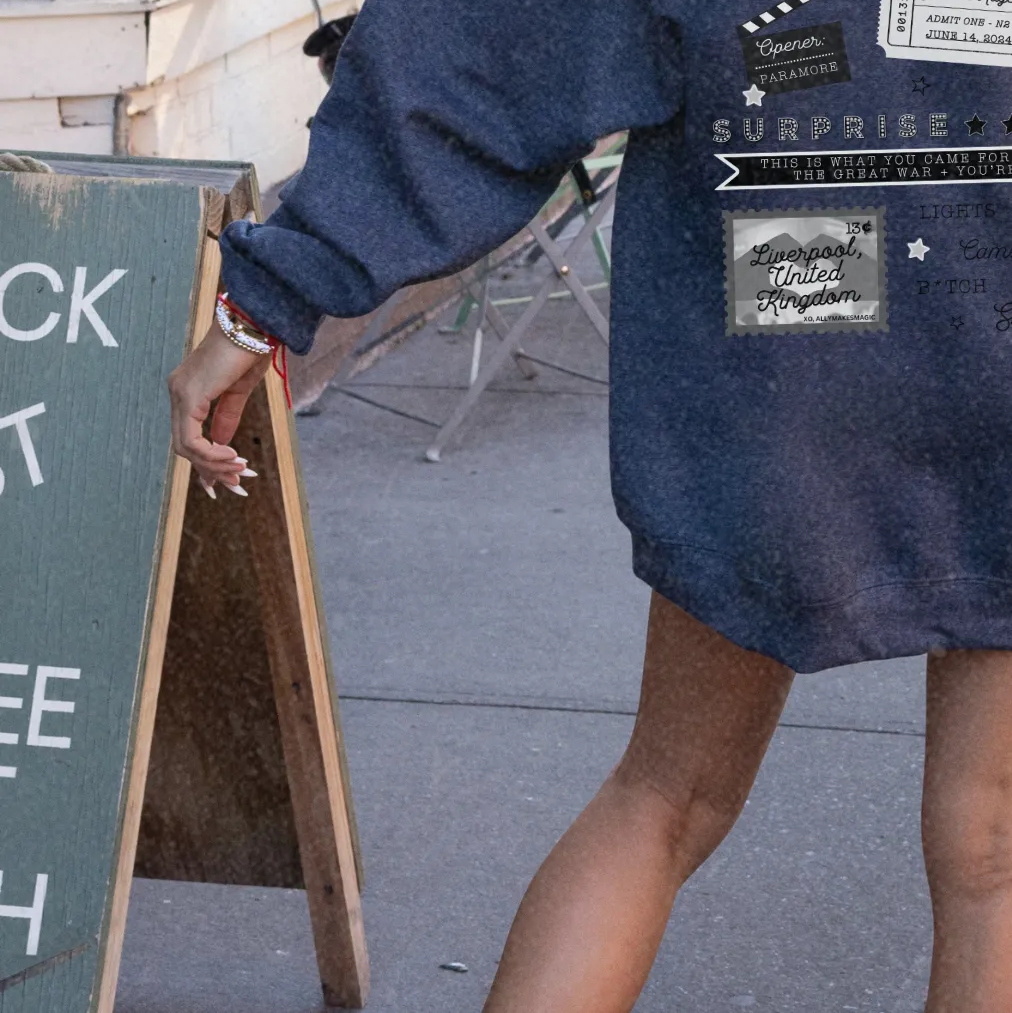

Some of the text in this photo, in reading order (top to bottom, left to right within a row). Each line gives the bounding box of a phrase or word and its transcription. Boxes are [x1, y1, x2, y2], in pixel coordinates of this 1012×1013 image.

[926, 14, 961, 25] ADMIT
[963, 16, 985, 27] ONE
[995, 19, 1011, 29] N2
[756, 36, 826, 59] Opener:
[925, 29, 1012, 46] JUNE 14, 2024
[760, 61, 838, 84] PARAMORE
[712, 112, 949, 143] SURPRISE
[761, 157, 799, 169] THIS
[806, 156, 822, 168] IS
[830, 155, 876, 167] WHAT
[884, 154, 916, 166] YOU
[924, 152, 970, 165] CAME
[978, 151, 1010, 163] FOR
[794, 169, 825, 181] THE
[834, 167, 889, 179] GREAT
[897, 166, 932, 178] WAR
[919, 203, 996, 220] LIGHTS
[750, 236, 862, 267] Liverpool,
[768, 259, 845, 287] United
[757, 284, 861, 317] Kingdom
[815, 314, 876, 323] ALLYMAKESMAGIC
